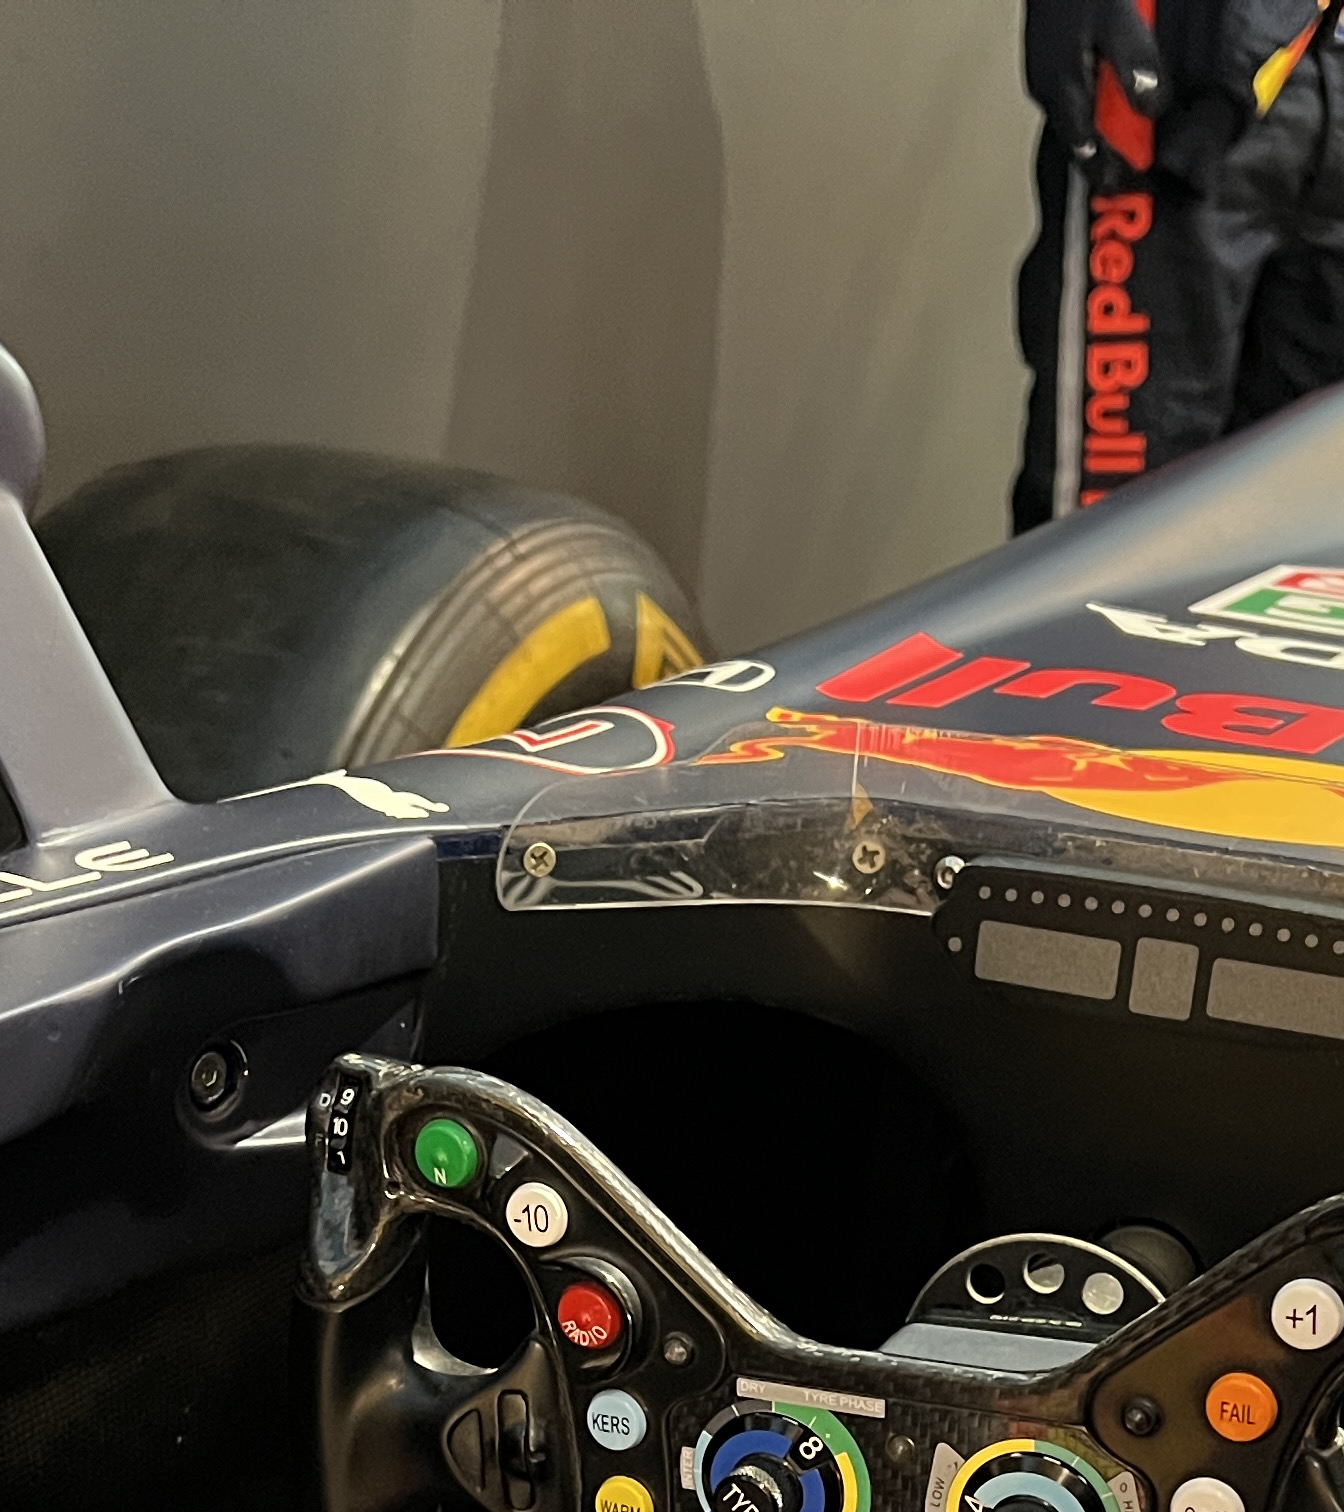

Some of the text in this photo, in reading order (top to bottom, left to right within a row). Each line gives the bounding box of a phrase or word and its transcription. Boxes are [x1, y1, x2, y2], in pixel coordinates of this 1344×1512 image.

[333, 1116, 348, 1136] 10
[434, 1167, 447, 1184] N
[513, 1204, 549, 1233] -10
[1285, 1304, 1318, 1335] +1
[562, 1320, 607, 1346] RADIO
[740, 1380, 883, 1413] DRY TYRE PHASE
[592, 1413, 630, 1435] KERS
[1219, 1401, 1256, 1426] FAIL
[798, 1436, 824, 1460] 8
[682, 1450, 694, 1487] INTER
[929, 1477, 945, 1507] LOW
